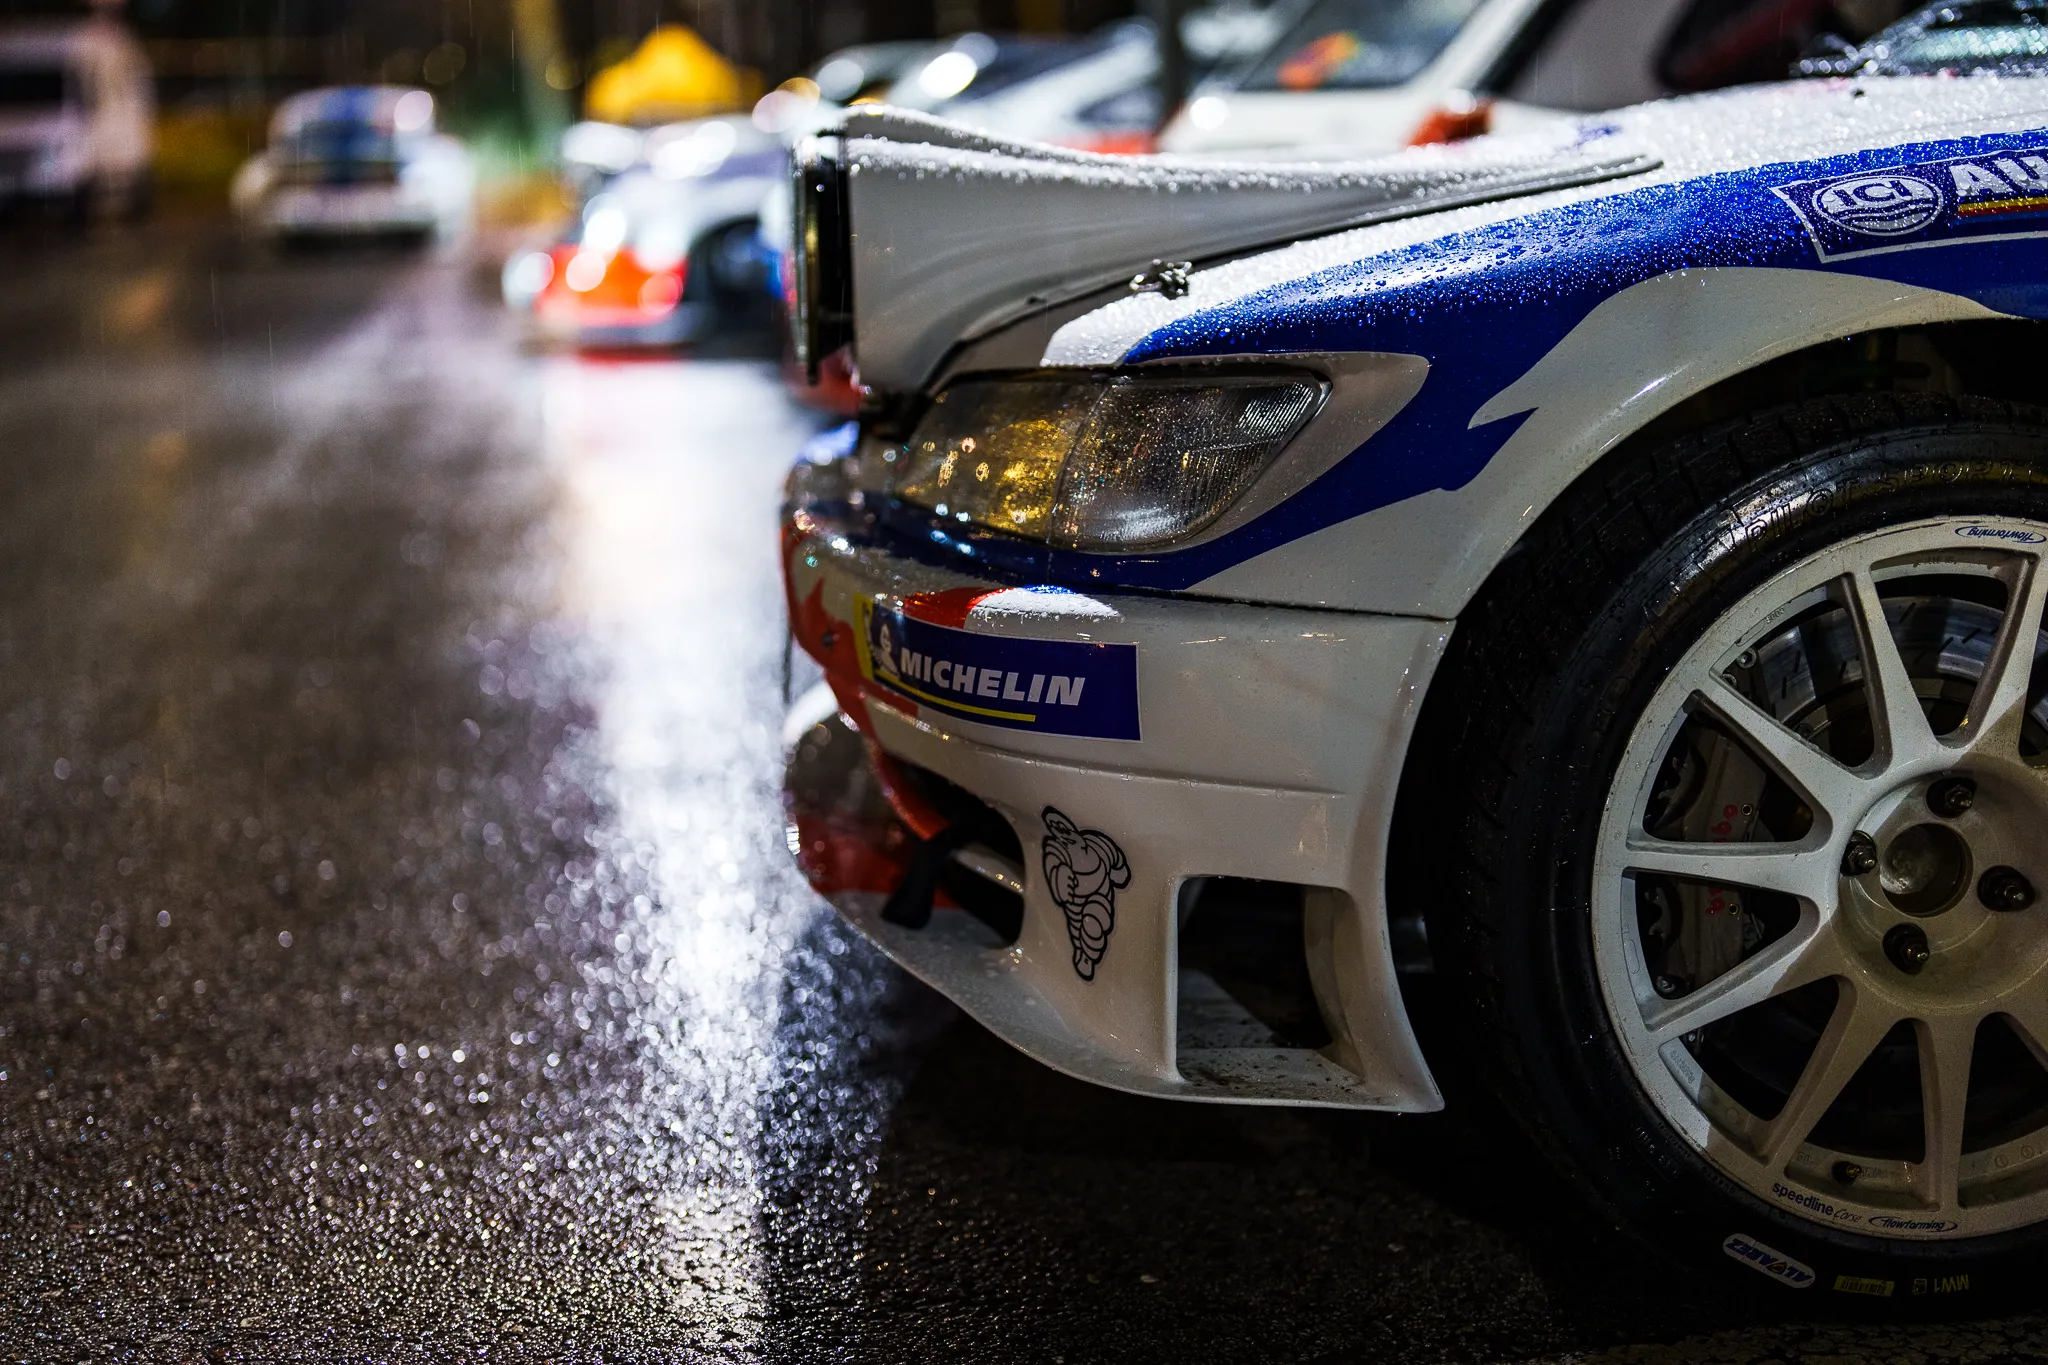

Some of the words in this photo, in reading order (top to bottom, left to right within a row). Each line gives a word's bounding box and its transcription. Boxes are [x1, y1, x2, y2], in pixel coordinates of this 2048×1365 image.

[1831, 179, 1913, 209] ICI
[901, 646, 1086, 706] MICHELIN
[1772, 1182, 1834, 1216] speedline
[1833, 1208, 1862, 1224] Corse
[1933, 1274, 1971, 1293] MW1
